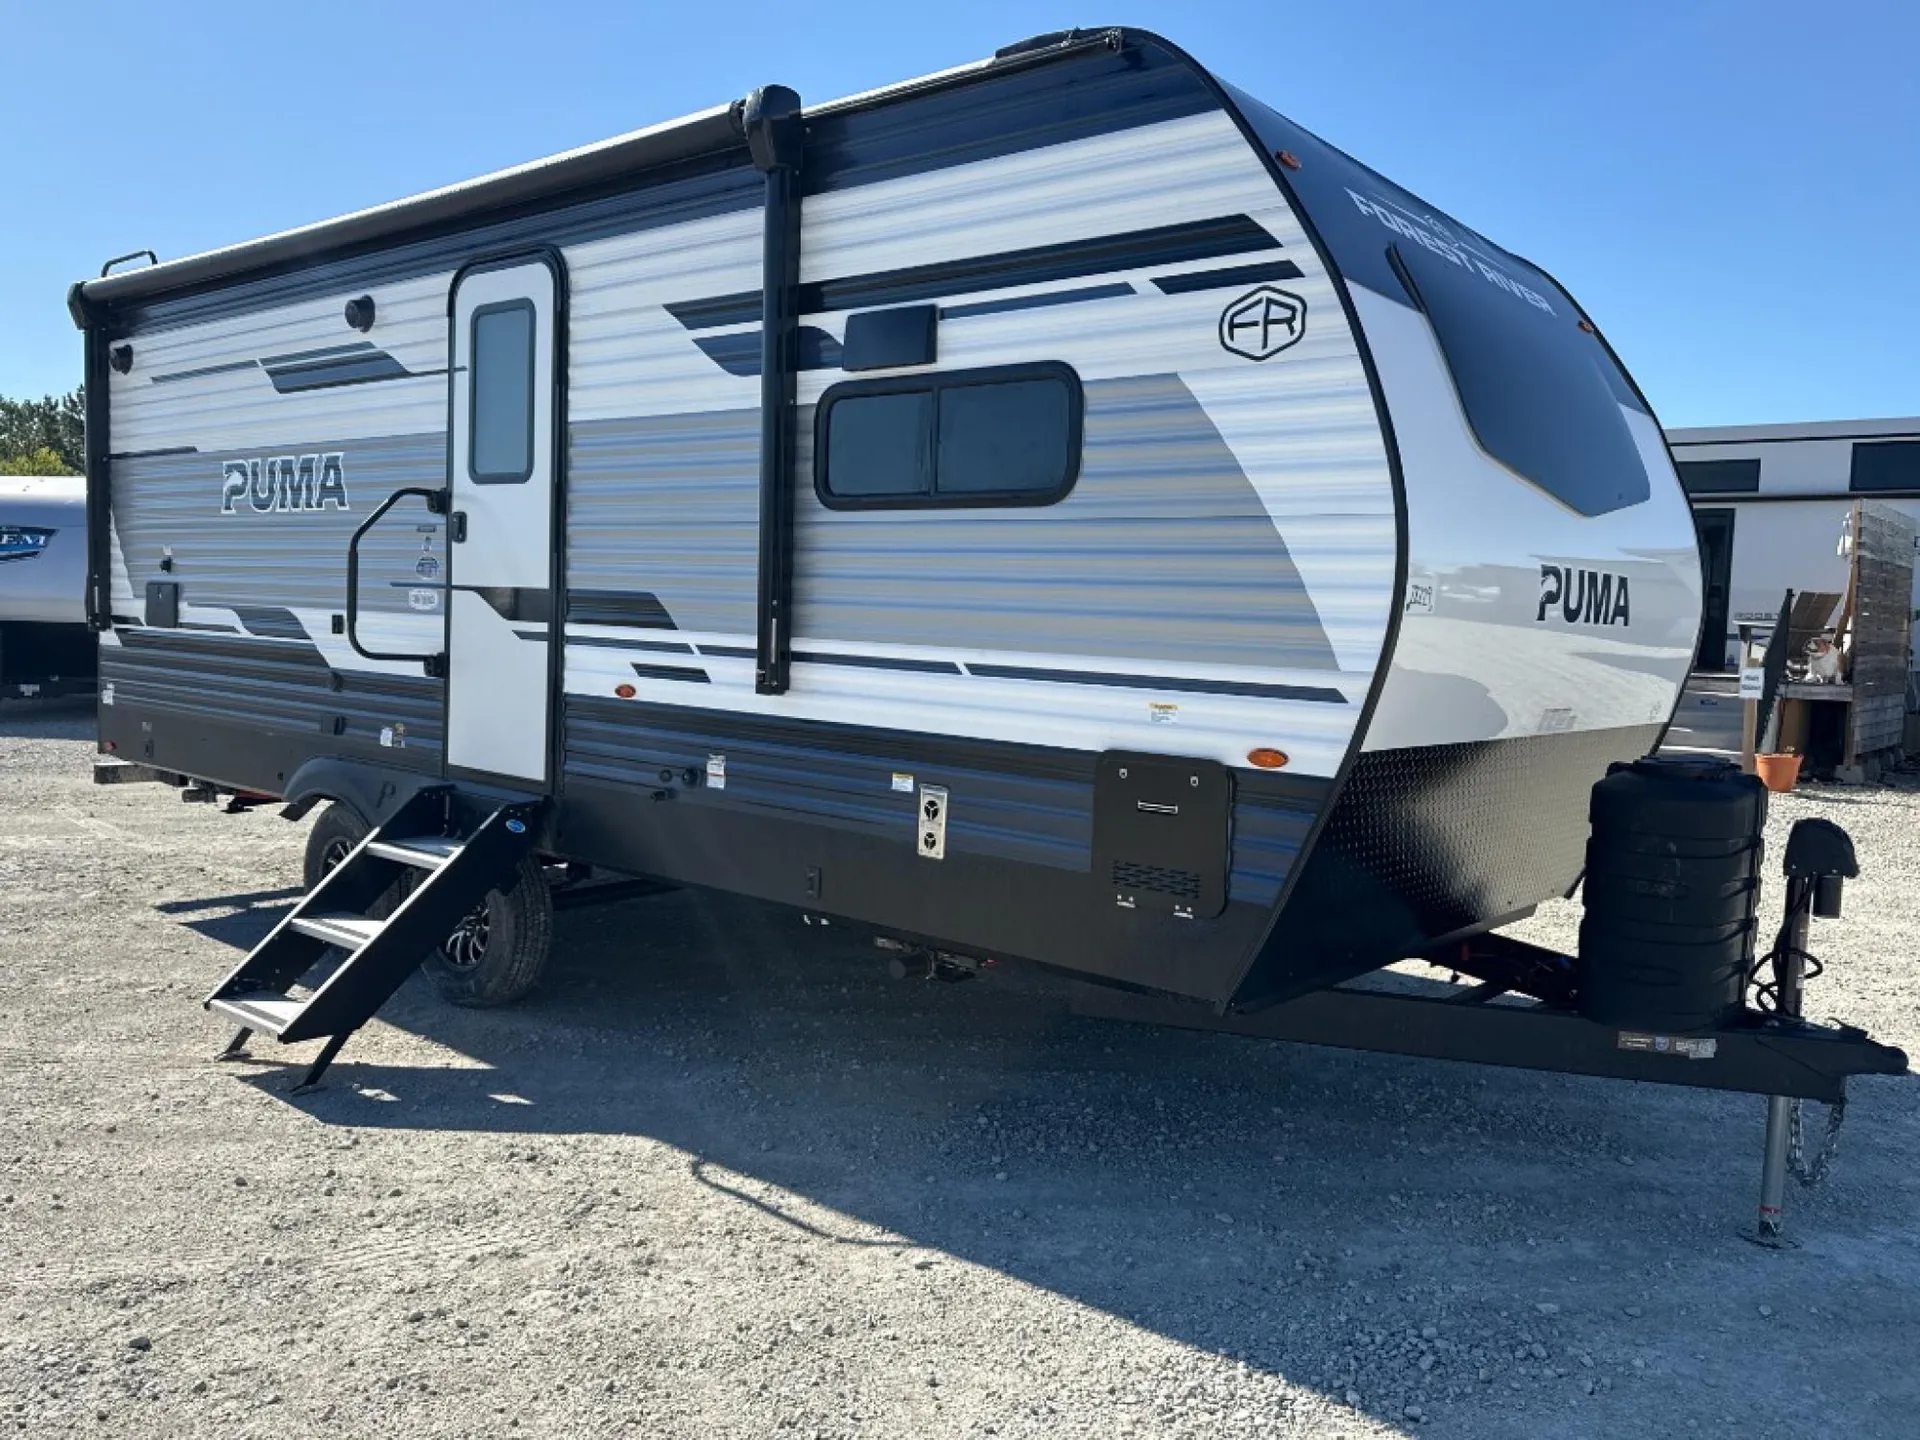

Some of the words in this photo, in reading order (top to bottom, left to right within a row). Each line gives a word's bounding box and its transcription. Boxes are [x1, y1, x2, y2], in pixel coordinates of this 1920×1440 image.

[1344, 187, 1475, 273] FOREST
[1472, 257, 1557, 317] RIVER
[221, 452, 350, 514] PUMA
[1536, 564, 1630, 627] PUMA
